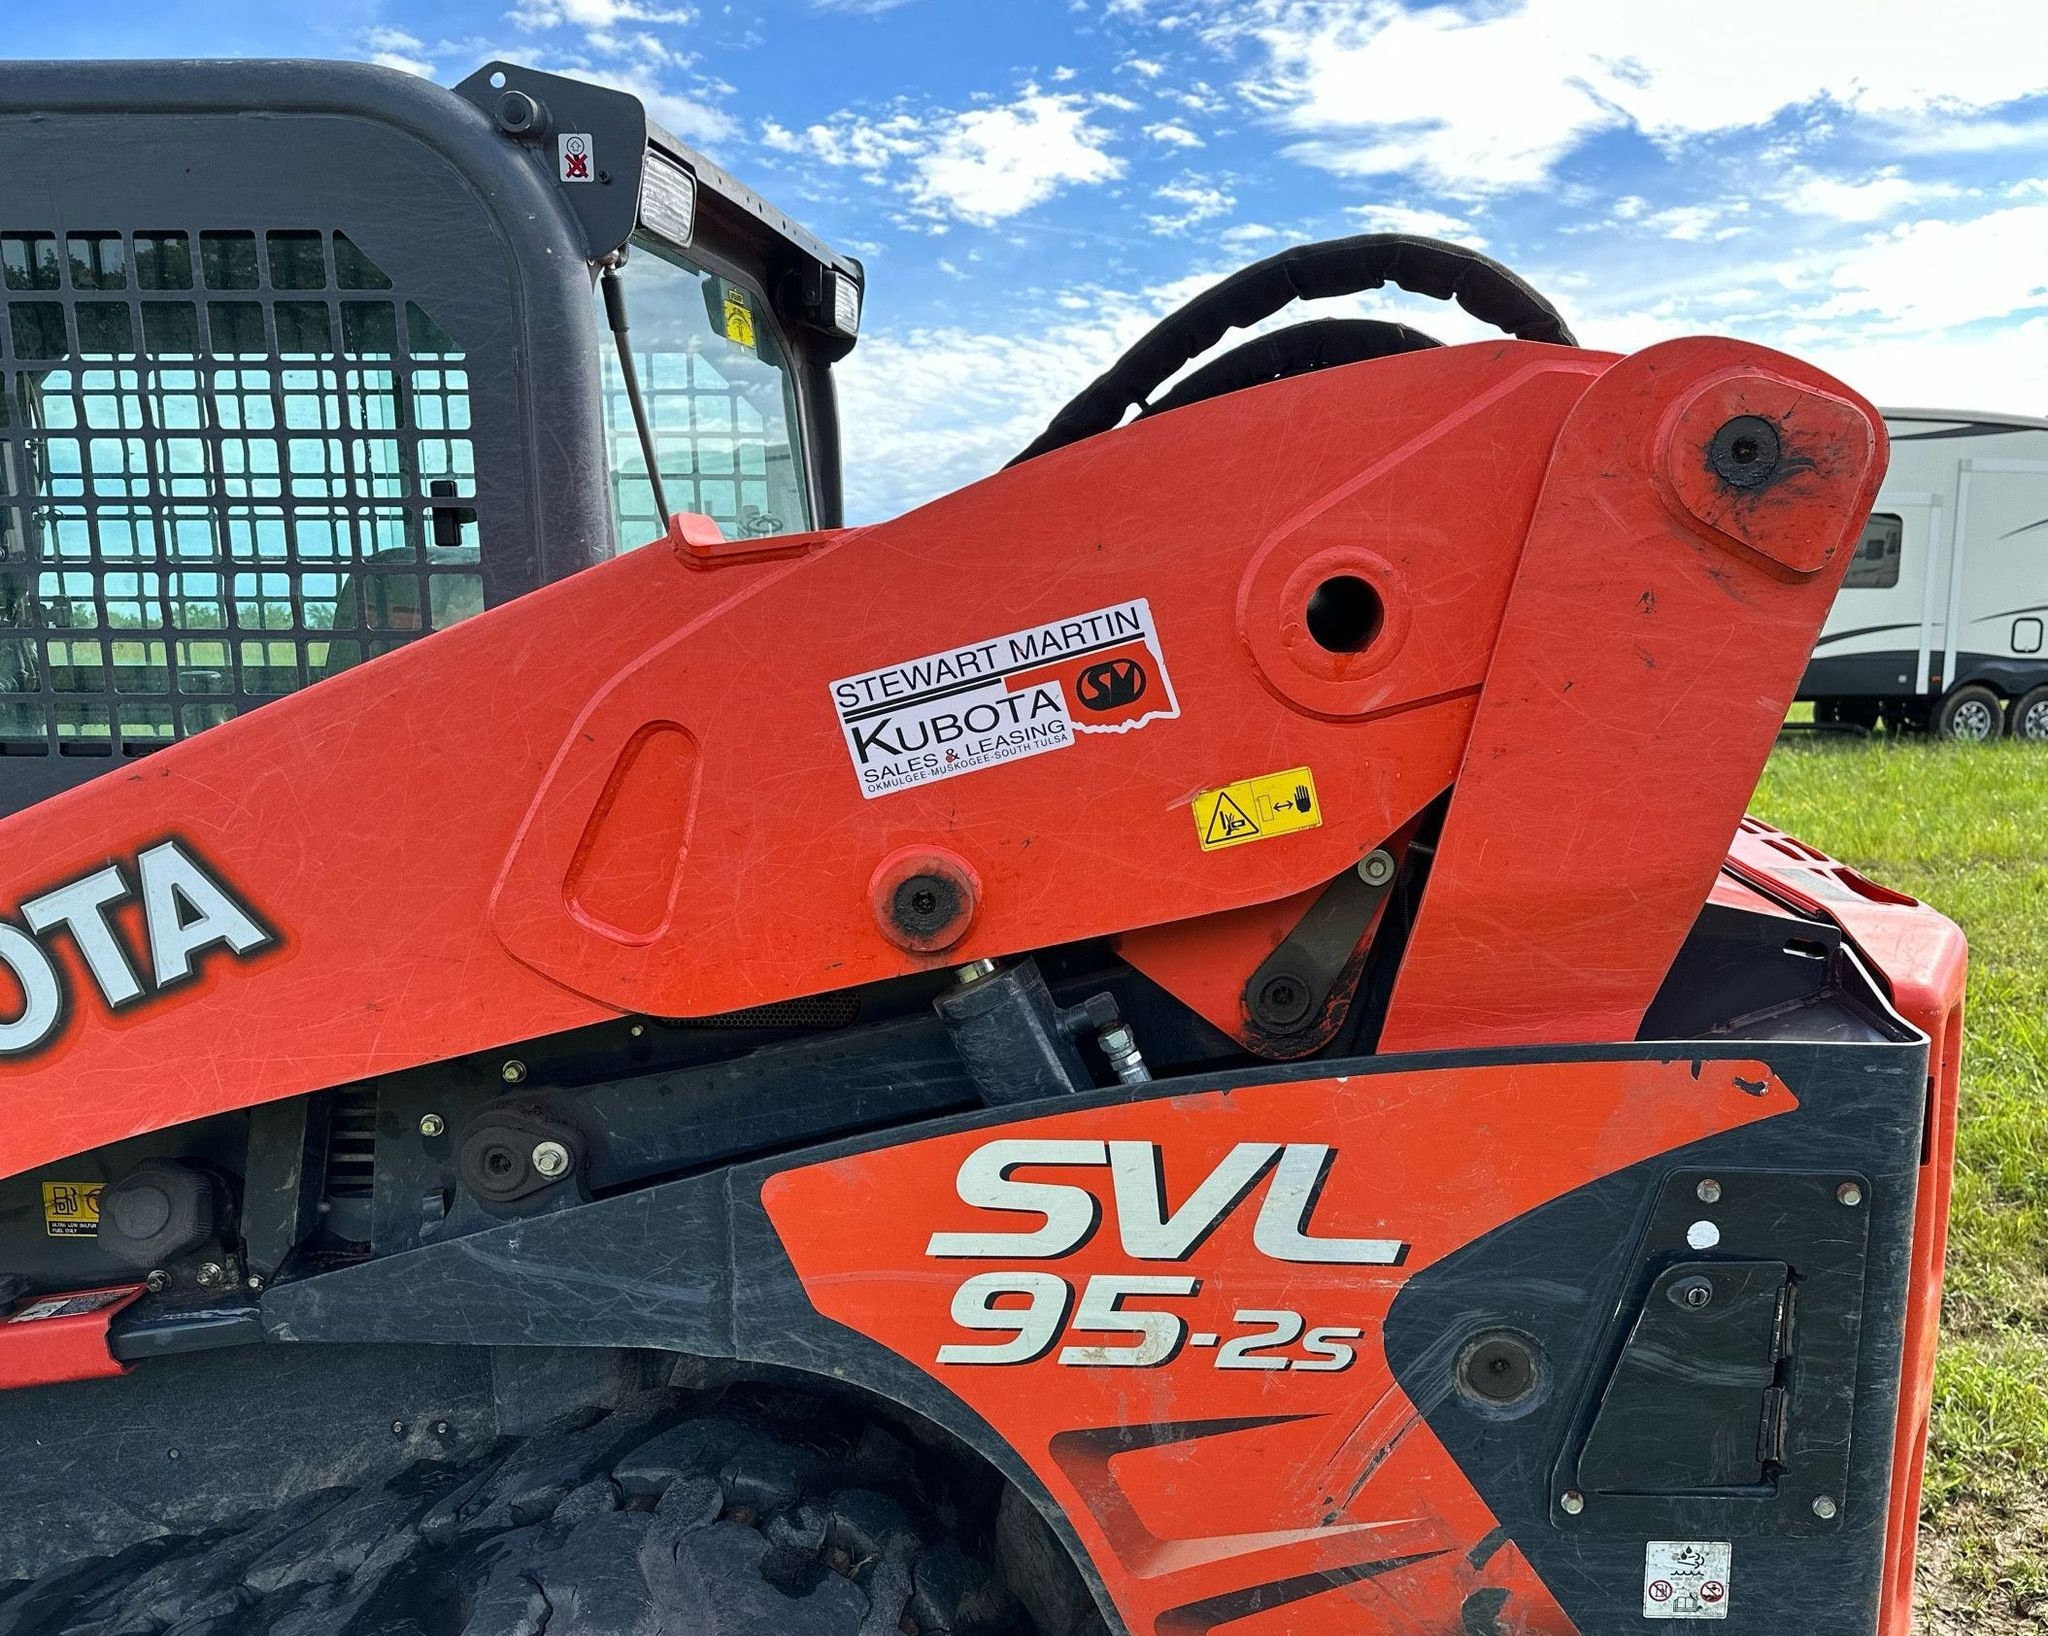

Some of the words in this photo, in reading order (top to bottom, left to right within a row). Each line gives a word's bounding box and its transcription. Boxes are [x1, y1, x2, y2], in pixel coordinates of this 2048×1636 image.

[836, 643, 998, 709] STEWART
[1008, 606, 1141, 664] MARTIN
[850, 688, 1063, 765] KUBOTA
[863, 752, 939, 783] SALES
[945, 748, 960, 764] &
[965, 719, 1066, 757] LEASING
[1034, 732, 1069, 749] TULSA
[925, 1139, 1407, 1265] SVL
